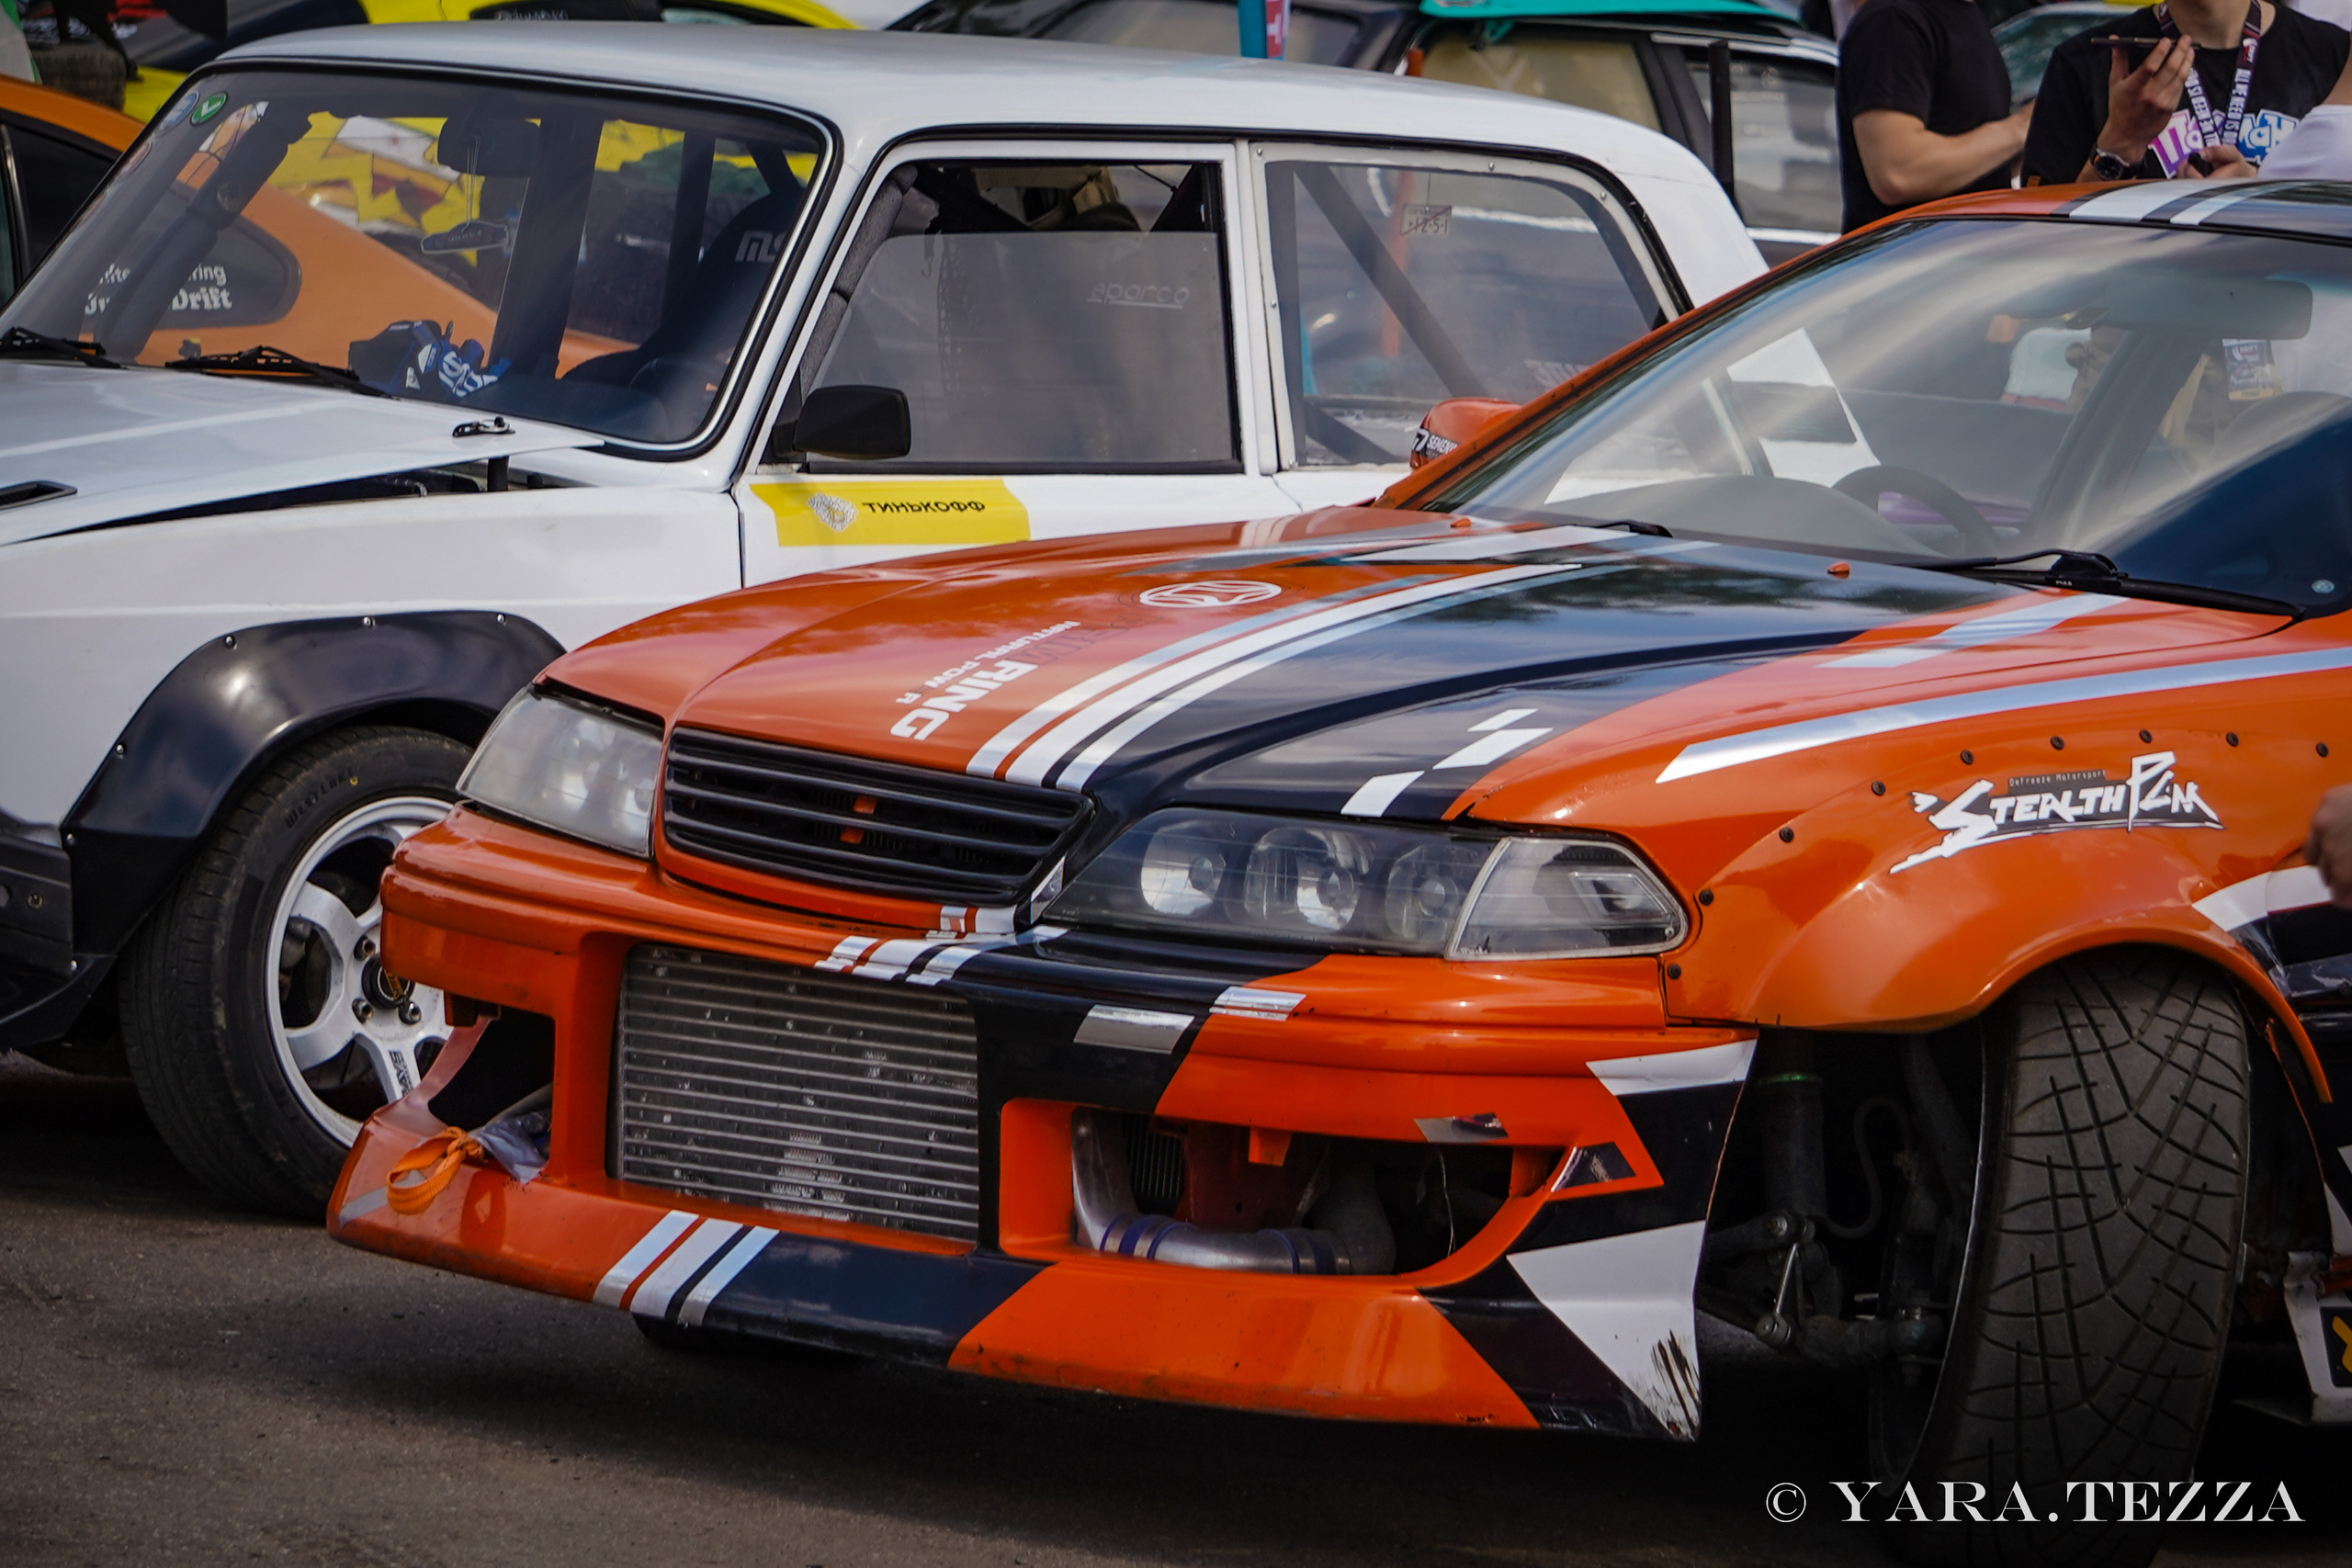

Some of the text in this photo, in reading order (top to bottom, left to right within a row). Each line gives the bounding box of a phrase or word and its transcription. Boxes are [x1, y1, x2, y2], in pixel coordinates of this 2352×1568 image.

[2227, 96, 2245, 119] NEED
[2224, 119, 2240, 130] IS
[171, 287, 232, 310] Drift
[861, 501, 985, 513] ТИНЬКОФФ
[975, 621, 1080, 660] NATURAL
[2055, 769, 2106, 782] Motorsport
